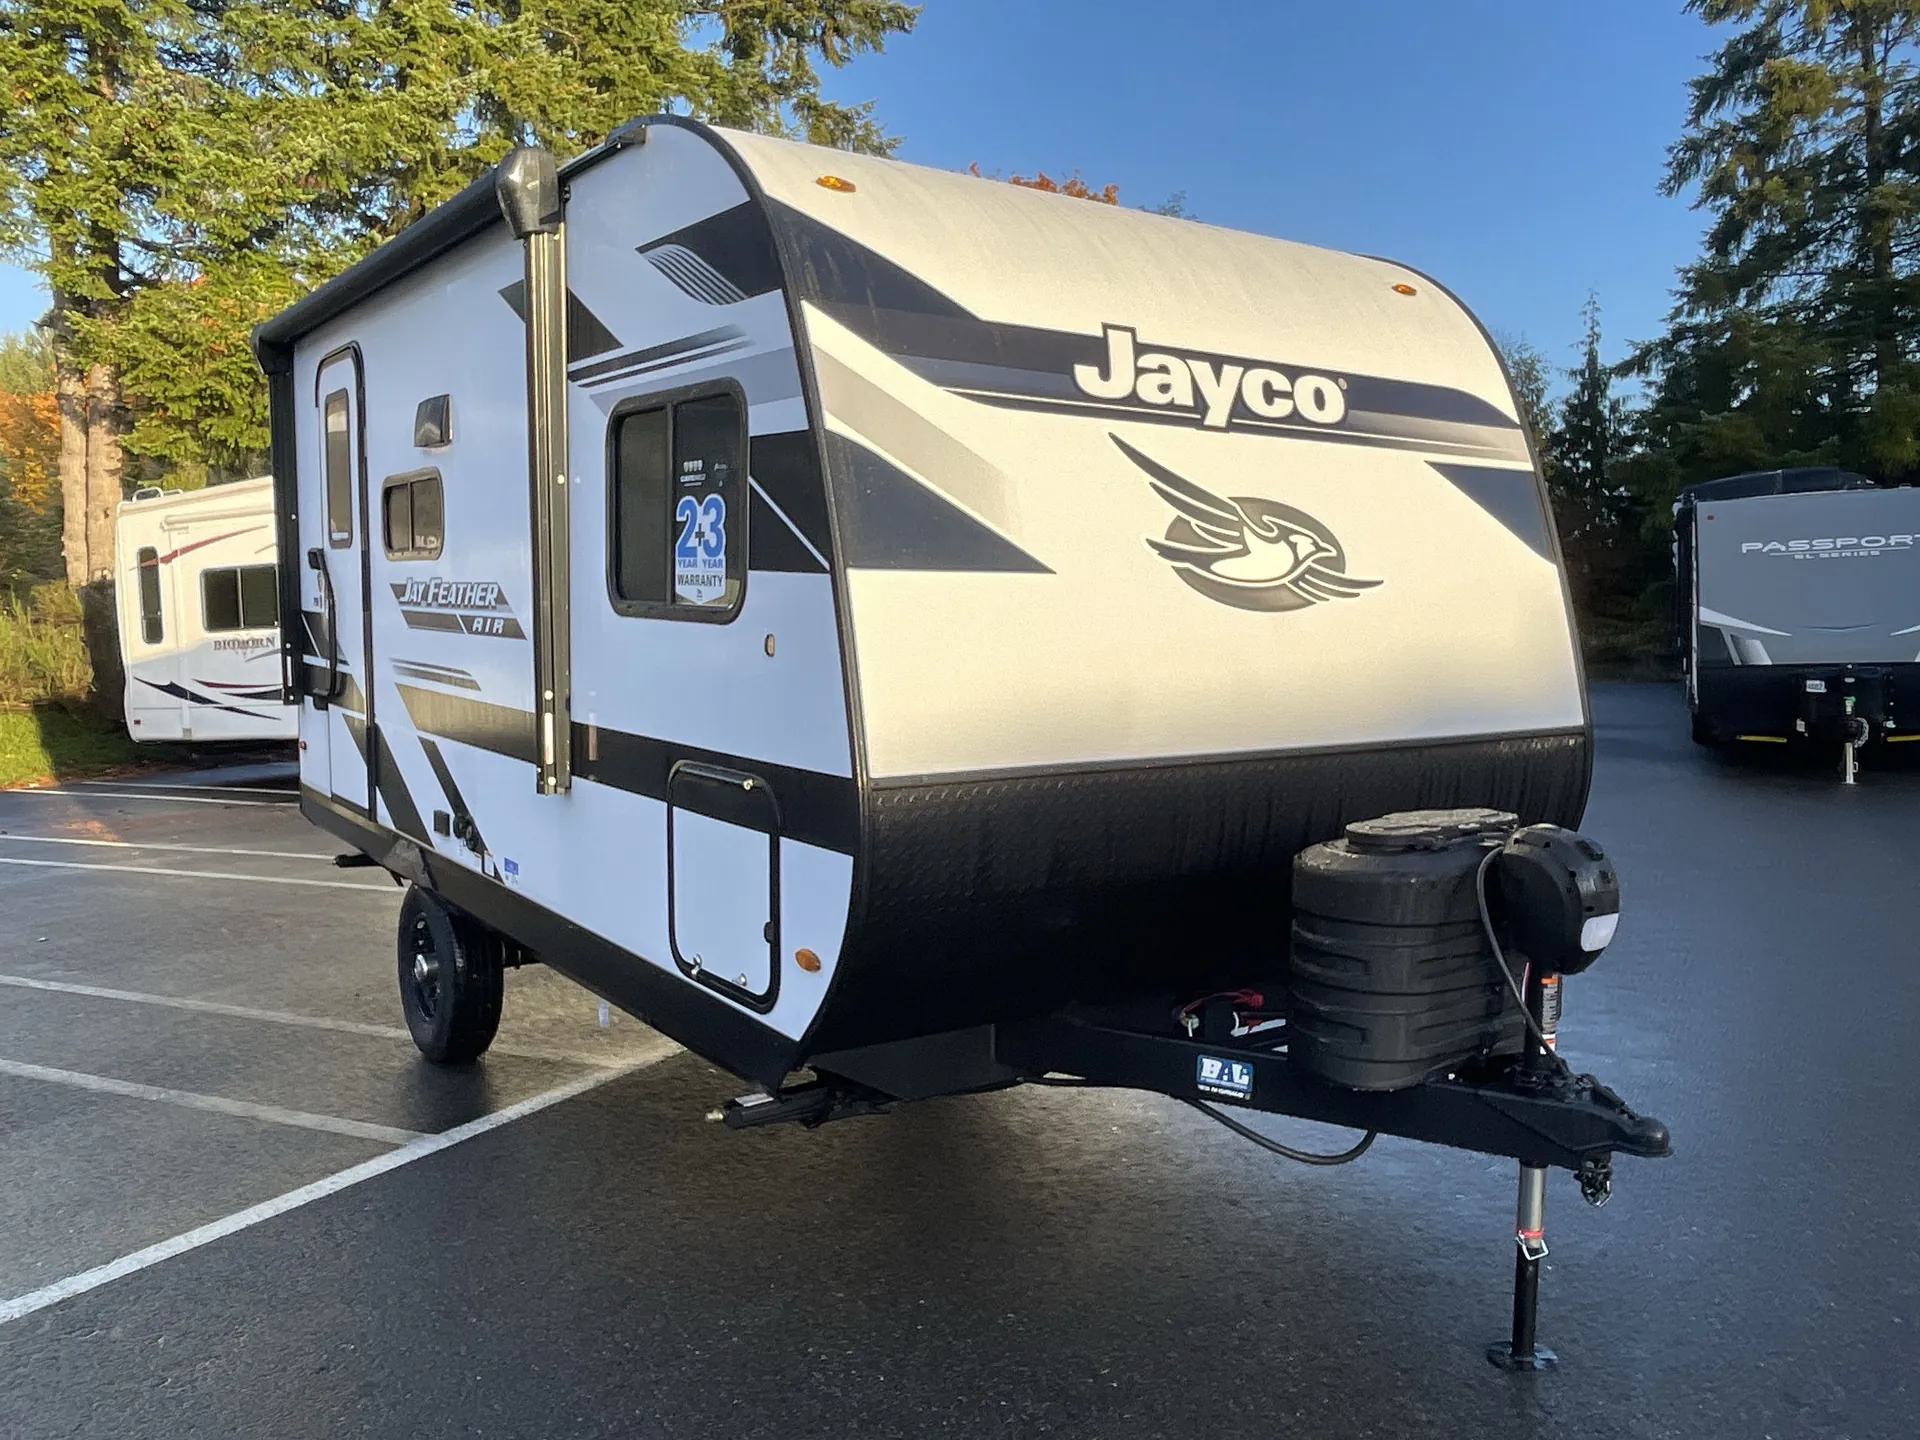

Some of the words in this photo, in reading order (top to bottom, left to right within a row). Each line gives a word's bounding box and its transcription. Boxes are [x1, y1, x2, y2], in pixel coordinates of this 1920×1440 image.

[1072, 326, 1346, 428] Jayco
[678, 558, 698, 569] YEAR
[702, 558, 724, 569] YEAR
[677, 573, 724, 588] WARRANTY
[472, 617, 505, 635] AIR
